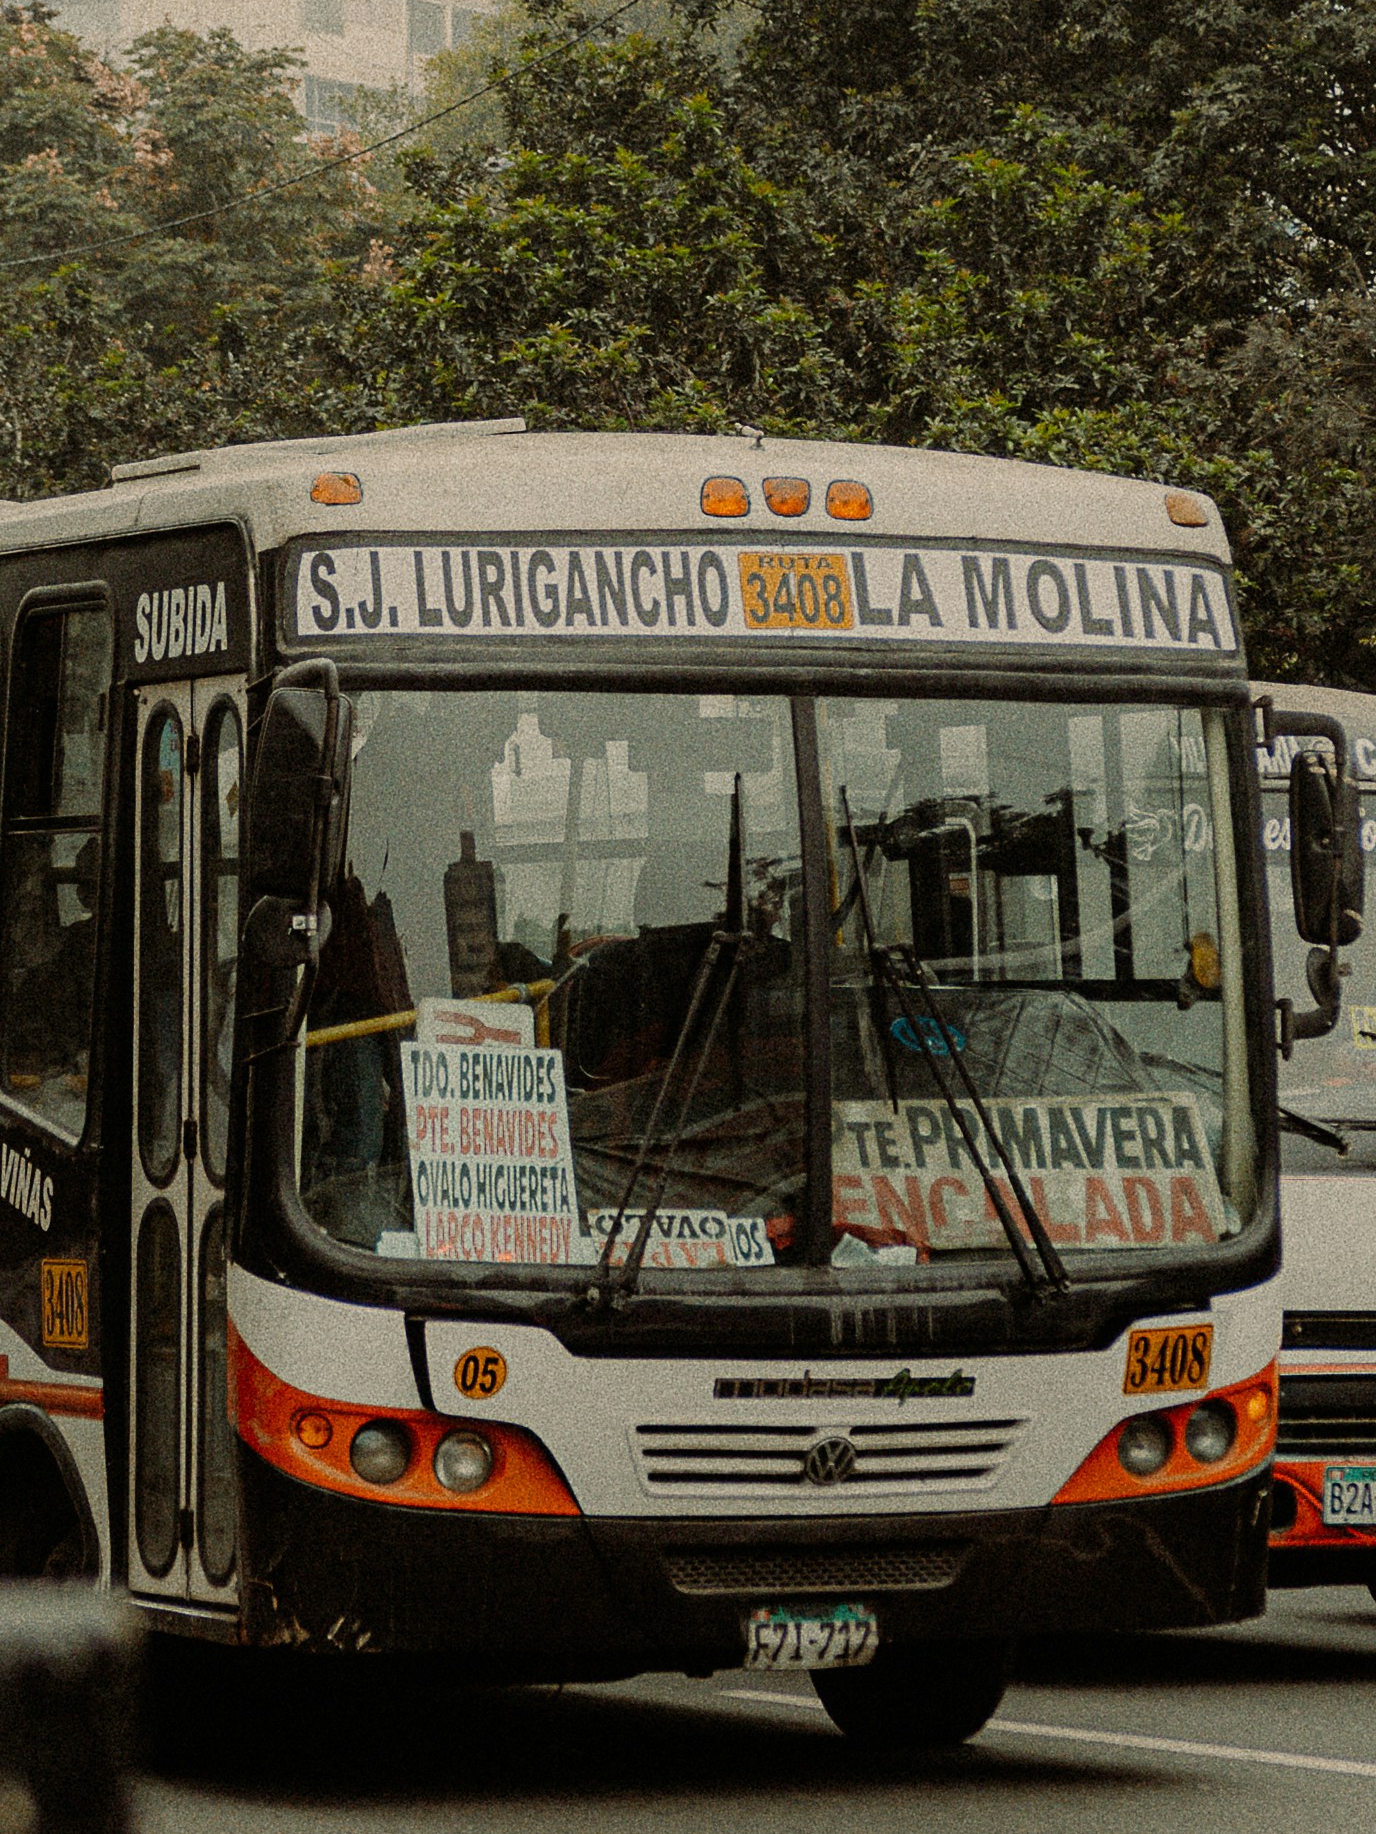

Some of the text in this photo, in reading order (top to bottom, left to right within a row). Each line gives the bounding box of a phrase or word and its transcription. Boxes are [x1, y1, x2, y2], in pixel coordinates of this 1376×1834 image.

[310, 549, 729, 631] S.J. LURIGANCHO
[747, 572, 845, 624] 3408
[851, 551, 1223, 649] LA MOLINA
[134, 581, 228, 664] SUBIDA
[411, 1050, 556, 1104] TDO. BENAVIDES
[460, 1106, 559, 1159] BENAVIDES
[908, 1106, 1206, 1171] PRIMAVERA
[0, 1141, 56, 1234] VIÑAS
[417, 1160, 572, 1214] OVALO HIGUERETA
[425, 1211, 572, 1264] LARCO KENNEDY
[45, 1269, 85, 1337] 3408
[459, 1355, 501, 1395] 05
[1130, 1331, 1210, 1388] 3408
